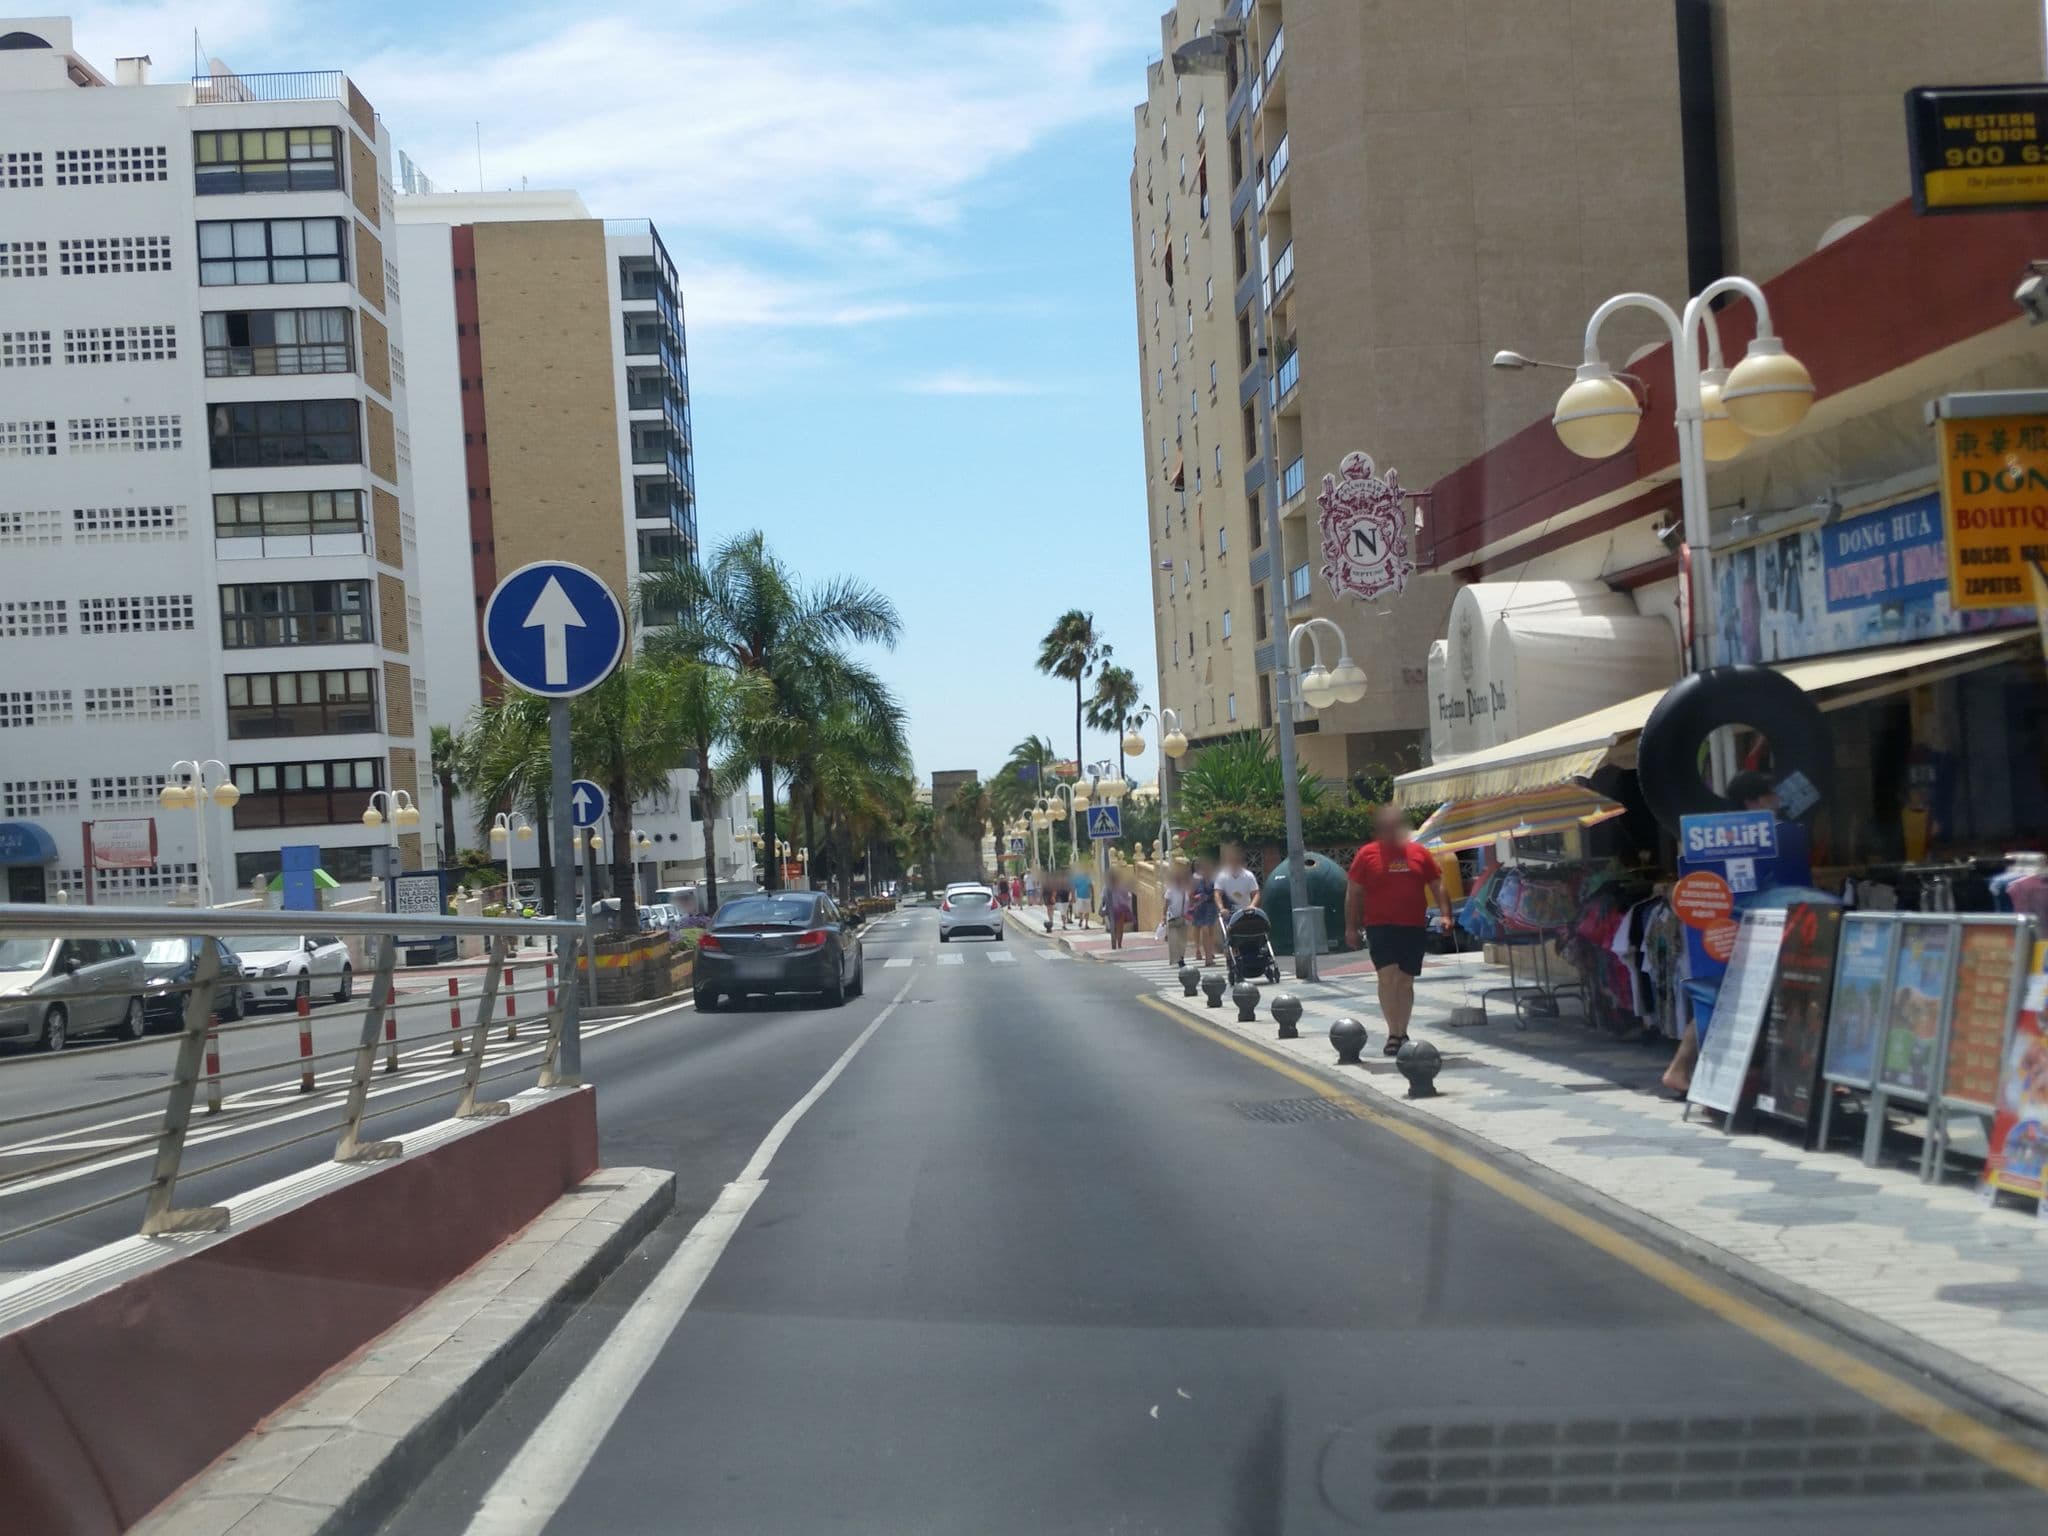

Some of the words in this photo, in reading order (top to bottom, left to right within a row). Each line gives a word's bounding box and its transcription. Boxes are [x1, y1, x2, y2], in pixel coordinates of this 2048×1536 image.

[1943, 112, 2036, 130] WESTERN
[1975, 128, 2038, 143] UNION
[1944, 146, 2005, 167] 900
[1961, 467, 2048, 495] DON
[1956, 504, 2048, 531] BOUTIQ
[1352, 528, 1377, 557] N
[1838, 522, 1886, 556] DONG
[1891, 510, 1932, 542] HUA
[1965, 576, 2022, 597] ZAPATOS
[1688, 826, 1732, 852] SEA
[399, 896, 439, 905] NEGRO
